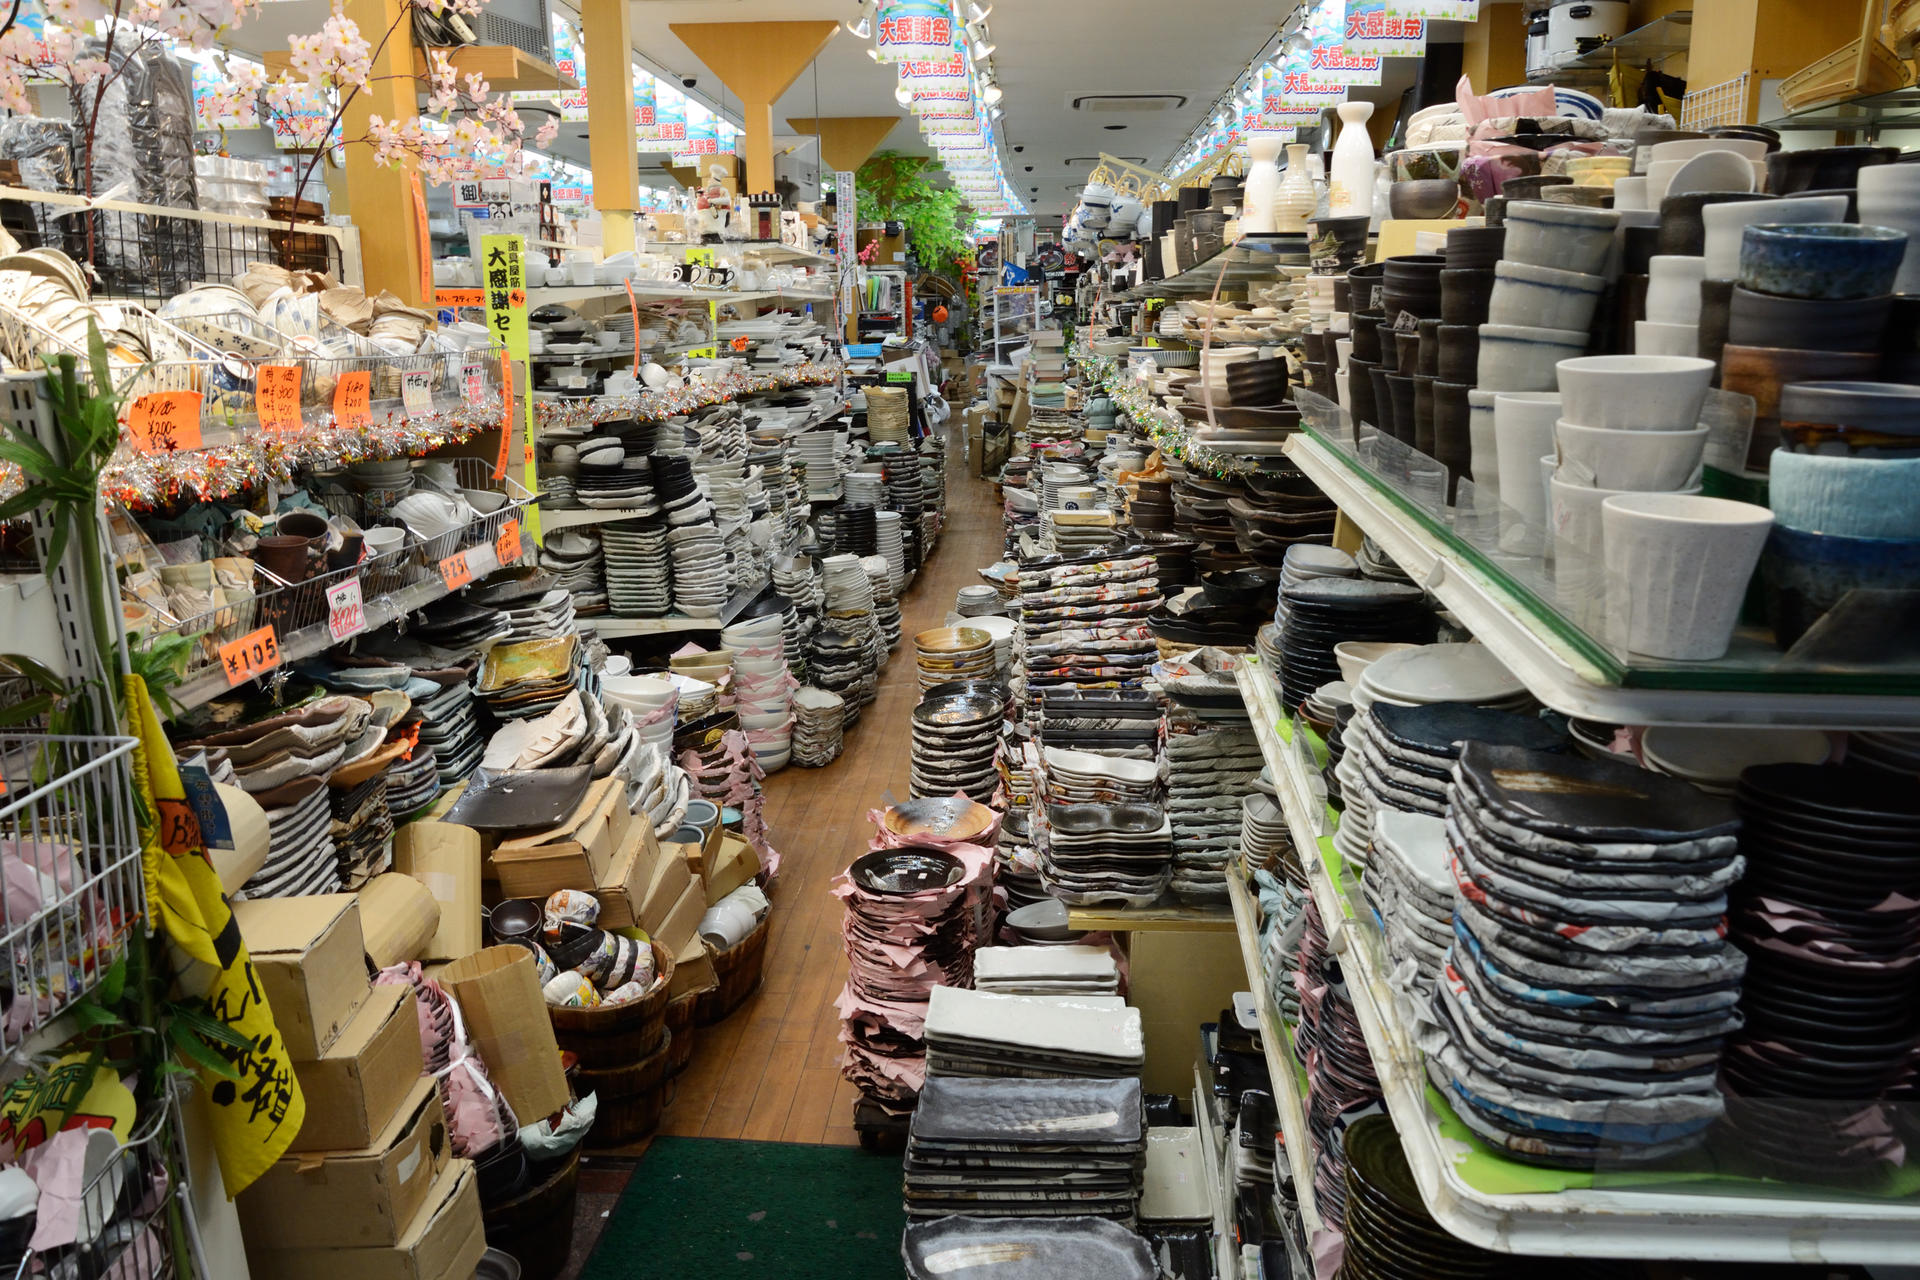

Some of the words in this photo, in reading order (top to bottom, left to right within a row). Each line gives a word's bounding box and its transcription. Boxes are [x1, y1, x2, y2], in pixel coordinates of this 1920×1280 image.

[879, 17, 950, 43] 大感謝祭
[1346, 10, 1423, 38] 大感謝祭
[507, 240, 521, 288] 道具屋筋
[488, 246, 511, 347] 大感謝セー
[225, 637, 277, 675] ¥105
